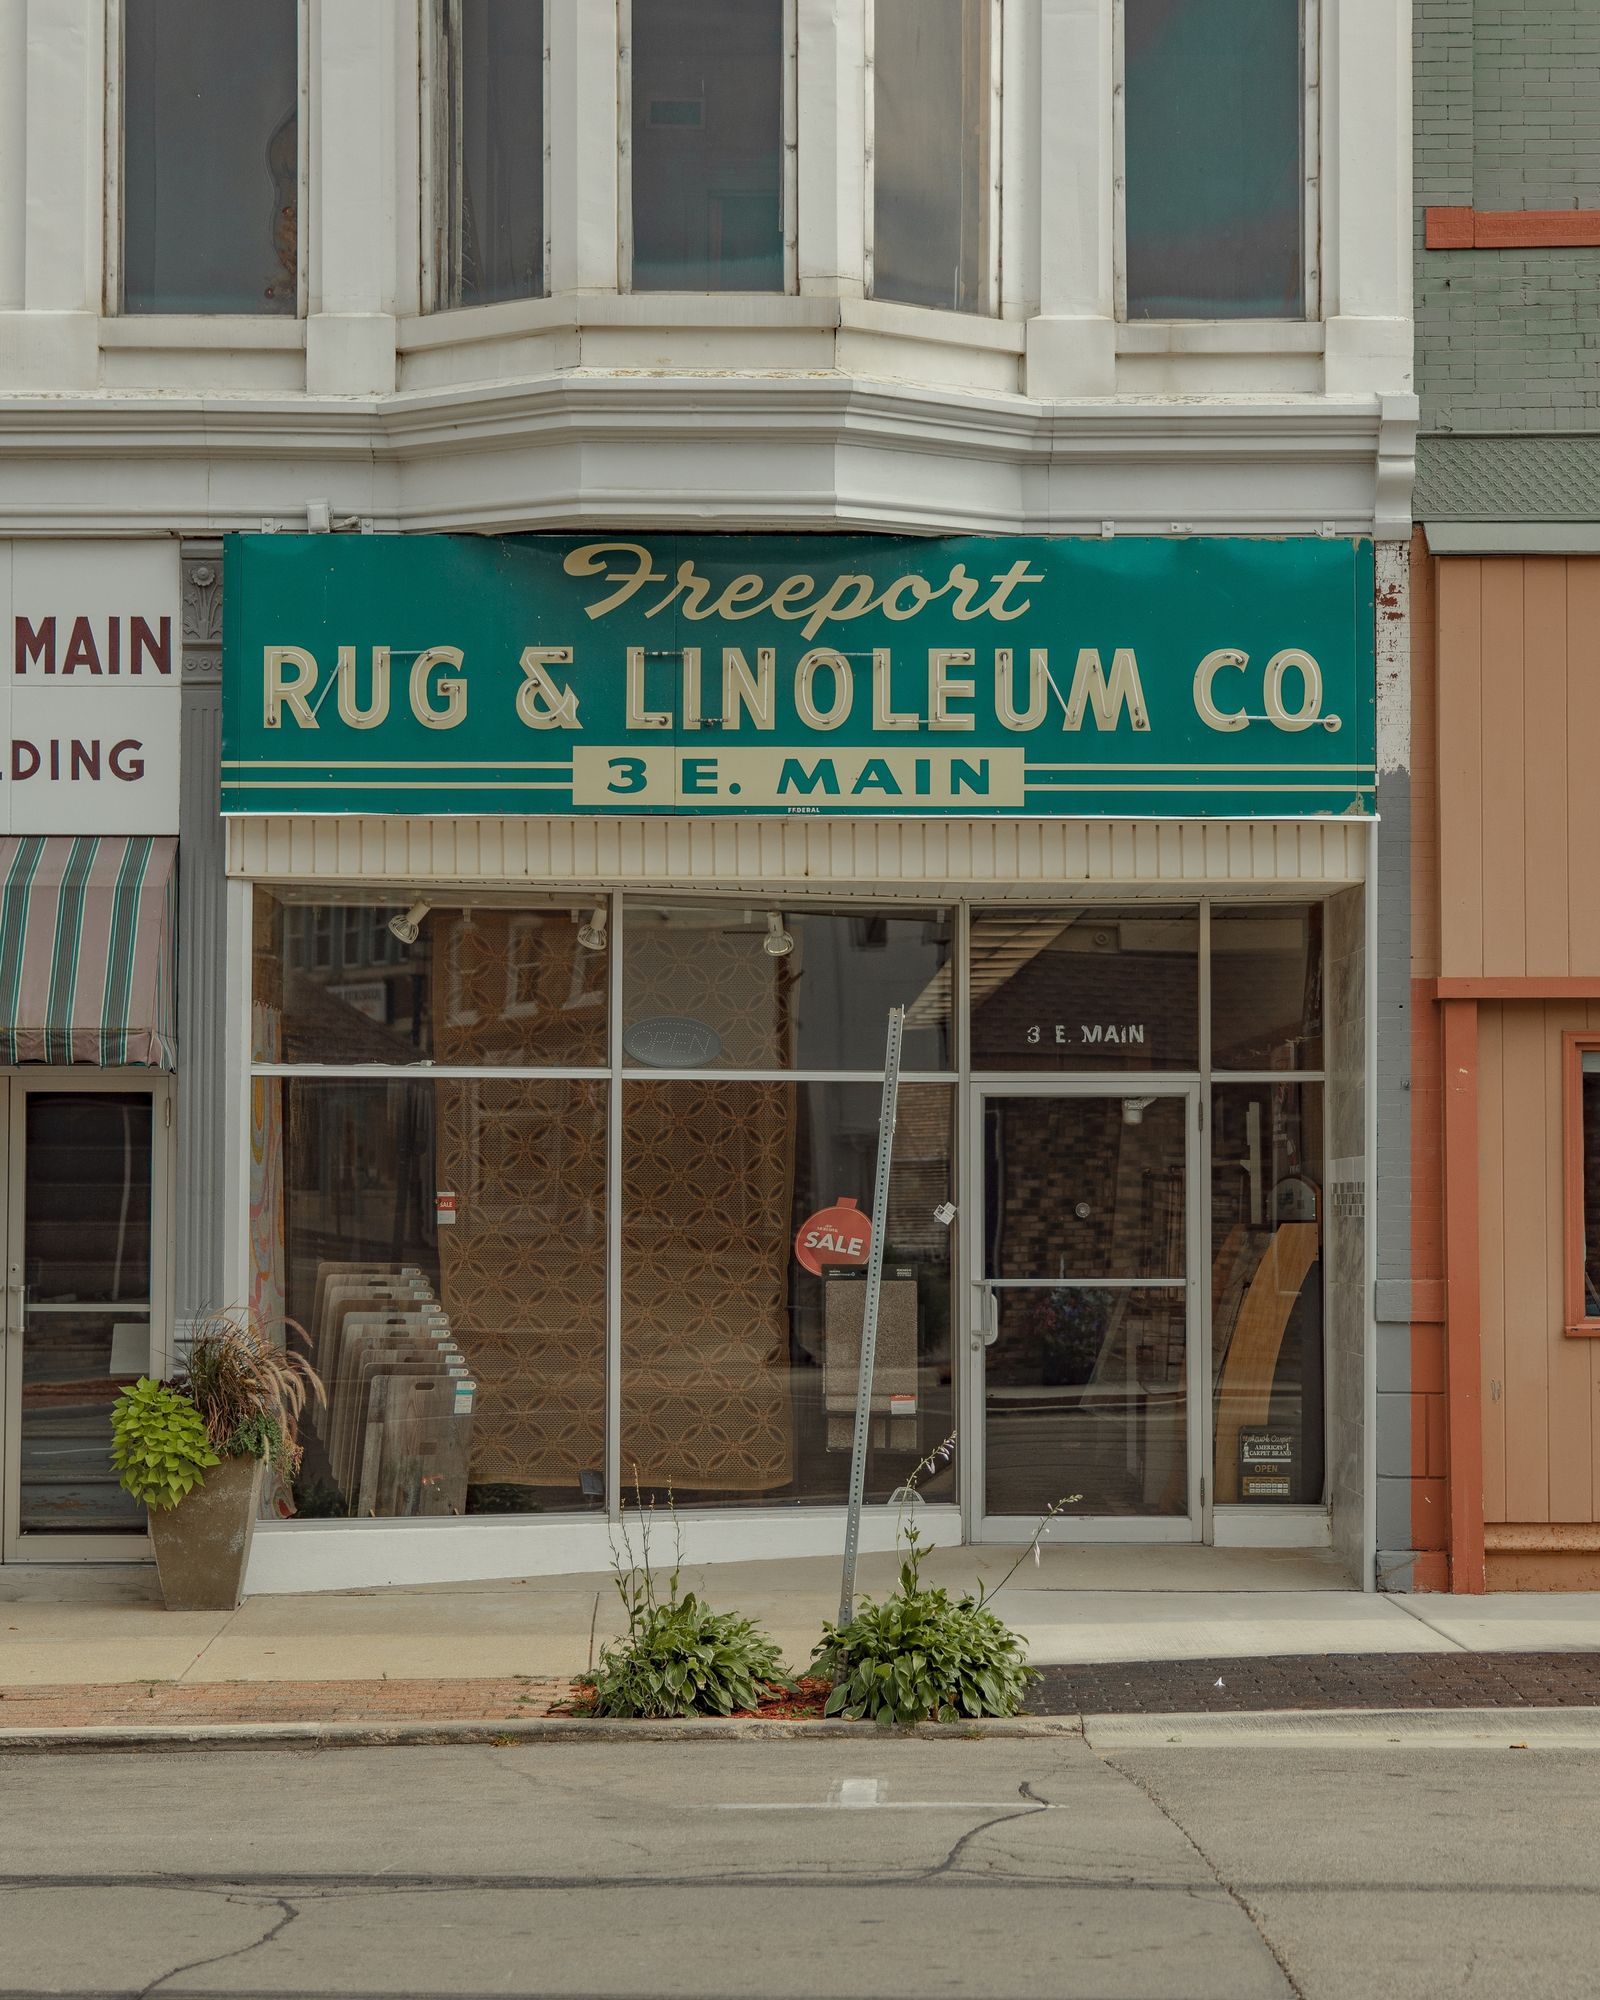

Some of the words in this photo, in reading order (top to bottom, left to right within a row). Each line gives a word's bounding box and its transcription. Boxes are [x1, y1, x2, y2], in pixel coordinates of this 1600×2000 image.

[563, 542, 1045, 641] Freeport
[15, 616, 171, 675] MAIN
[263, 645, 468, 730] RUG
[515, 645, 584, 730] &
[625, 646, 1151, 733] LINOLEUM
[1192, 647, 1342, 733] CO.
[0, 739, 145, 782] DING
[606, 757, 647, 795] 3
[681, 757, 741, 795] E.
[776, 757, 990, 795] MAIN
[631, 1030, 712, 1057] OPEN
[1027, 1025, 1041, 1043] 3
[1055, 1025, 1071, 1043] E.
[1081, 1024, 1144, 1043] MAIN
[804, 1231, 864, 1256] SALE
[1254, 1464, 1278, 1473] OPEN
